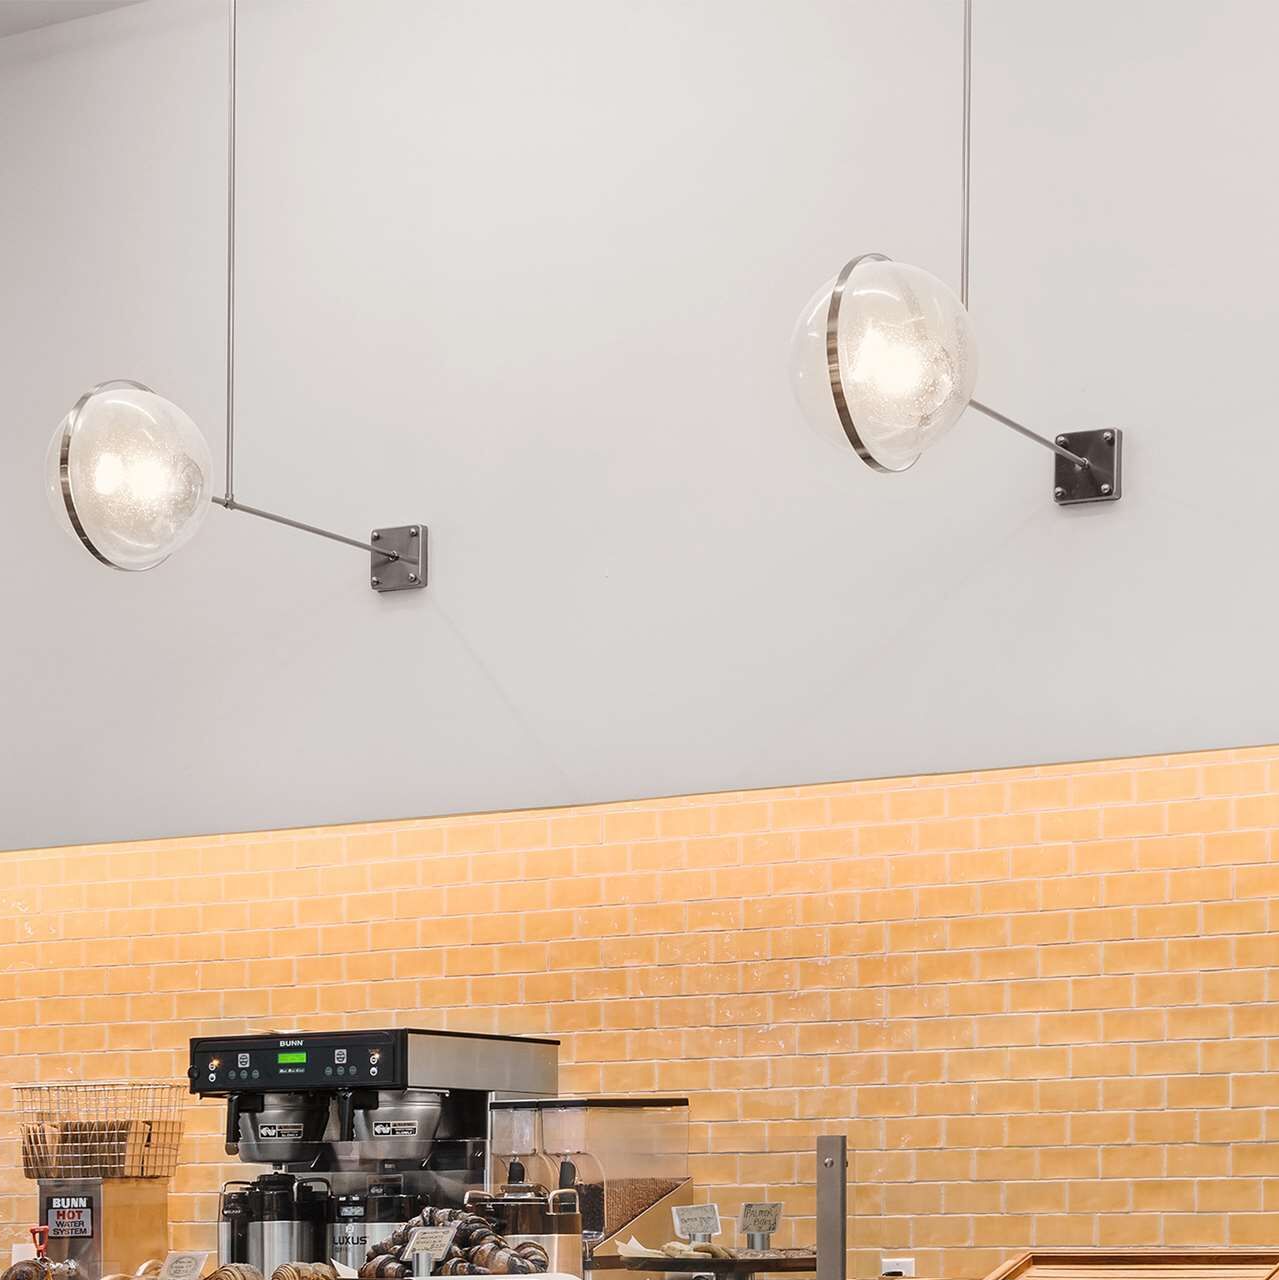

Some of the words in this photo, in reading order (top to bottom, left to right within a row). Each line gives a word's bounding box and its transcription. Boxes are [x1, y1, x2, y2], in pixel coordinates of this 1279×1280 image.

[52, 1197, 87, 1208] BUNN
[56, 1210, 83, 1220] HOT
[55, 1220, 85, 1228] WATER
[52, 1228, 88, 1236] SYSTEM
[332, 1236, 368, 1246] LUXUS
